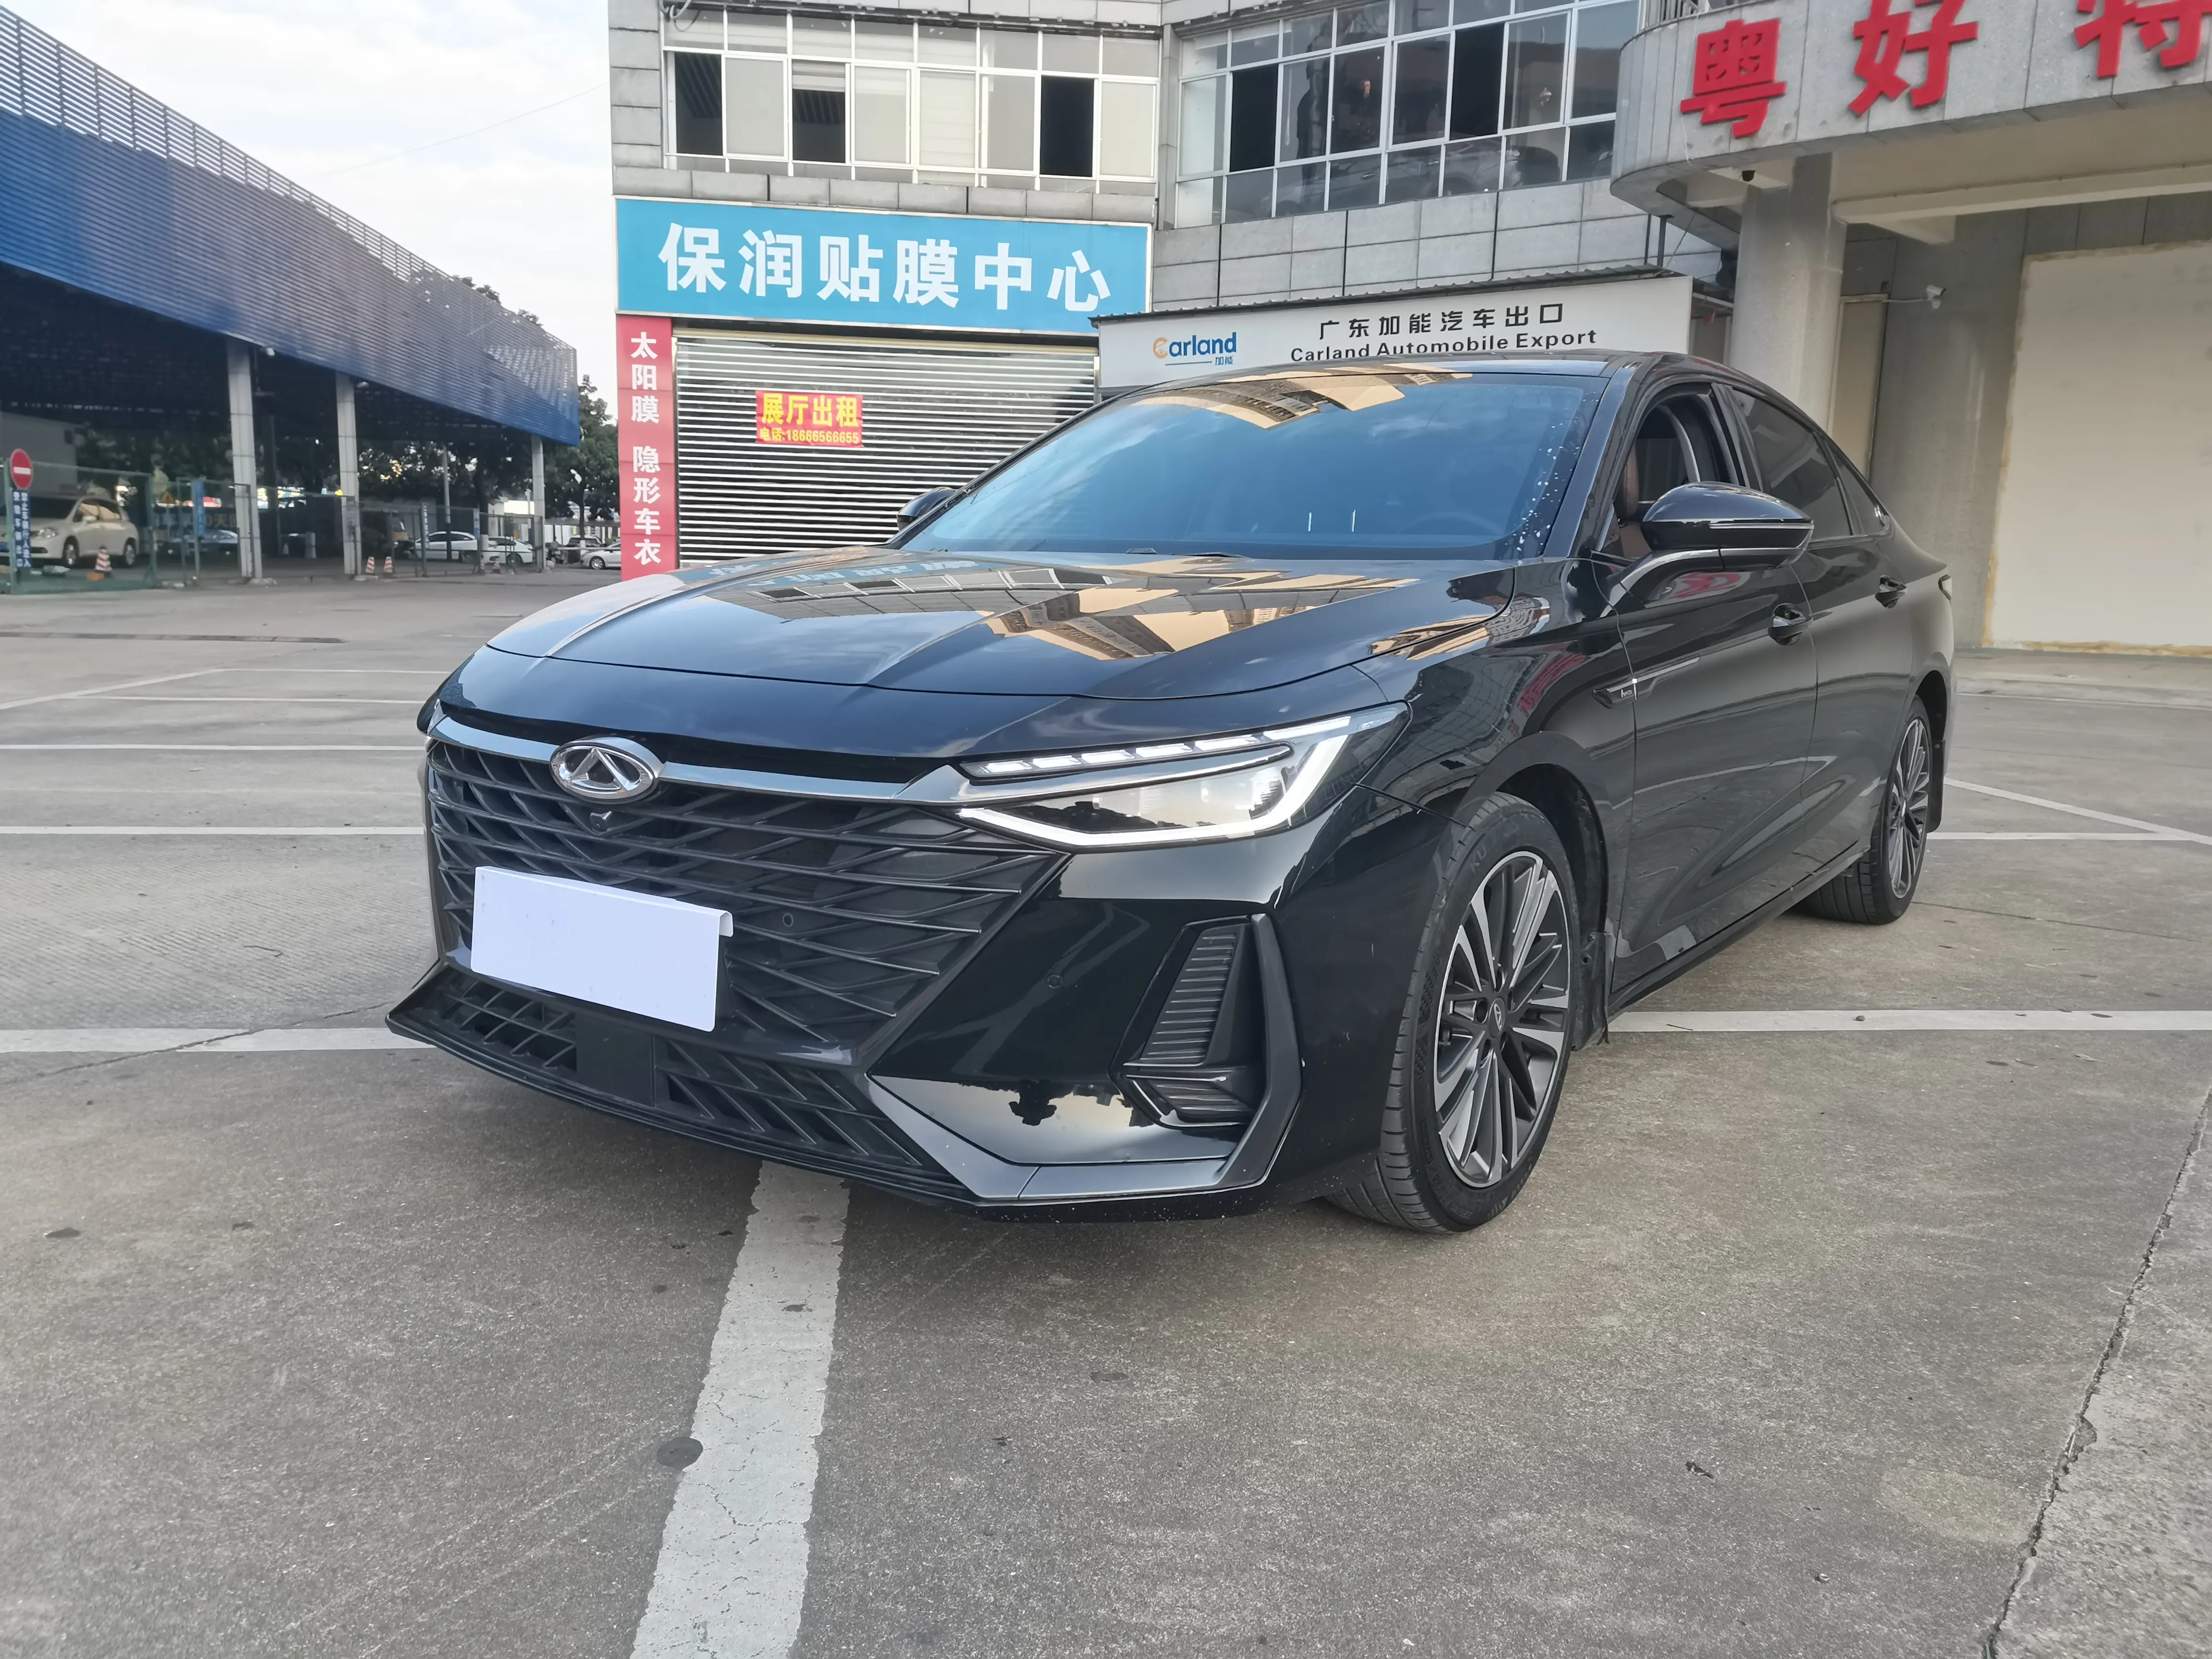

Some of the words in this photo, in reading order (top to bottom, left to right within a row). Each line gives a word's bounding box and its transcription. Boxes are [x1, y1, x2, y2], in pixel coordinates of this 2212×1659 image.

[658, 222, 1111, 312] 保润贴膜中心
[1319, 303, 1563, 340] 广东加能汽车出口
[1153, 332, 1237, 359] Carland
[1290, 343, 1370, 361] Carland
[1376, 335, 1508, 356] Automobile
[1516, 330, 1597, 349] Export
[630, 331, 660, 424] 太阳膜
[761, 393, 859, 427] 展厅出租
[632, 445, 662, 565] 隐形车衣
